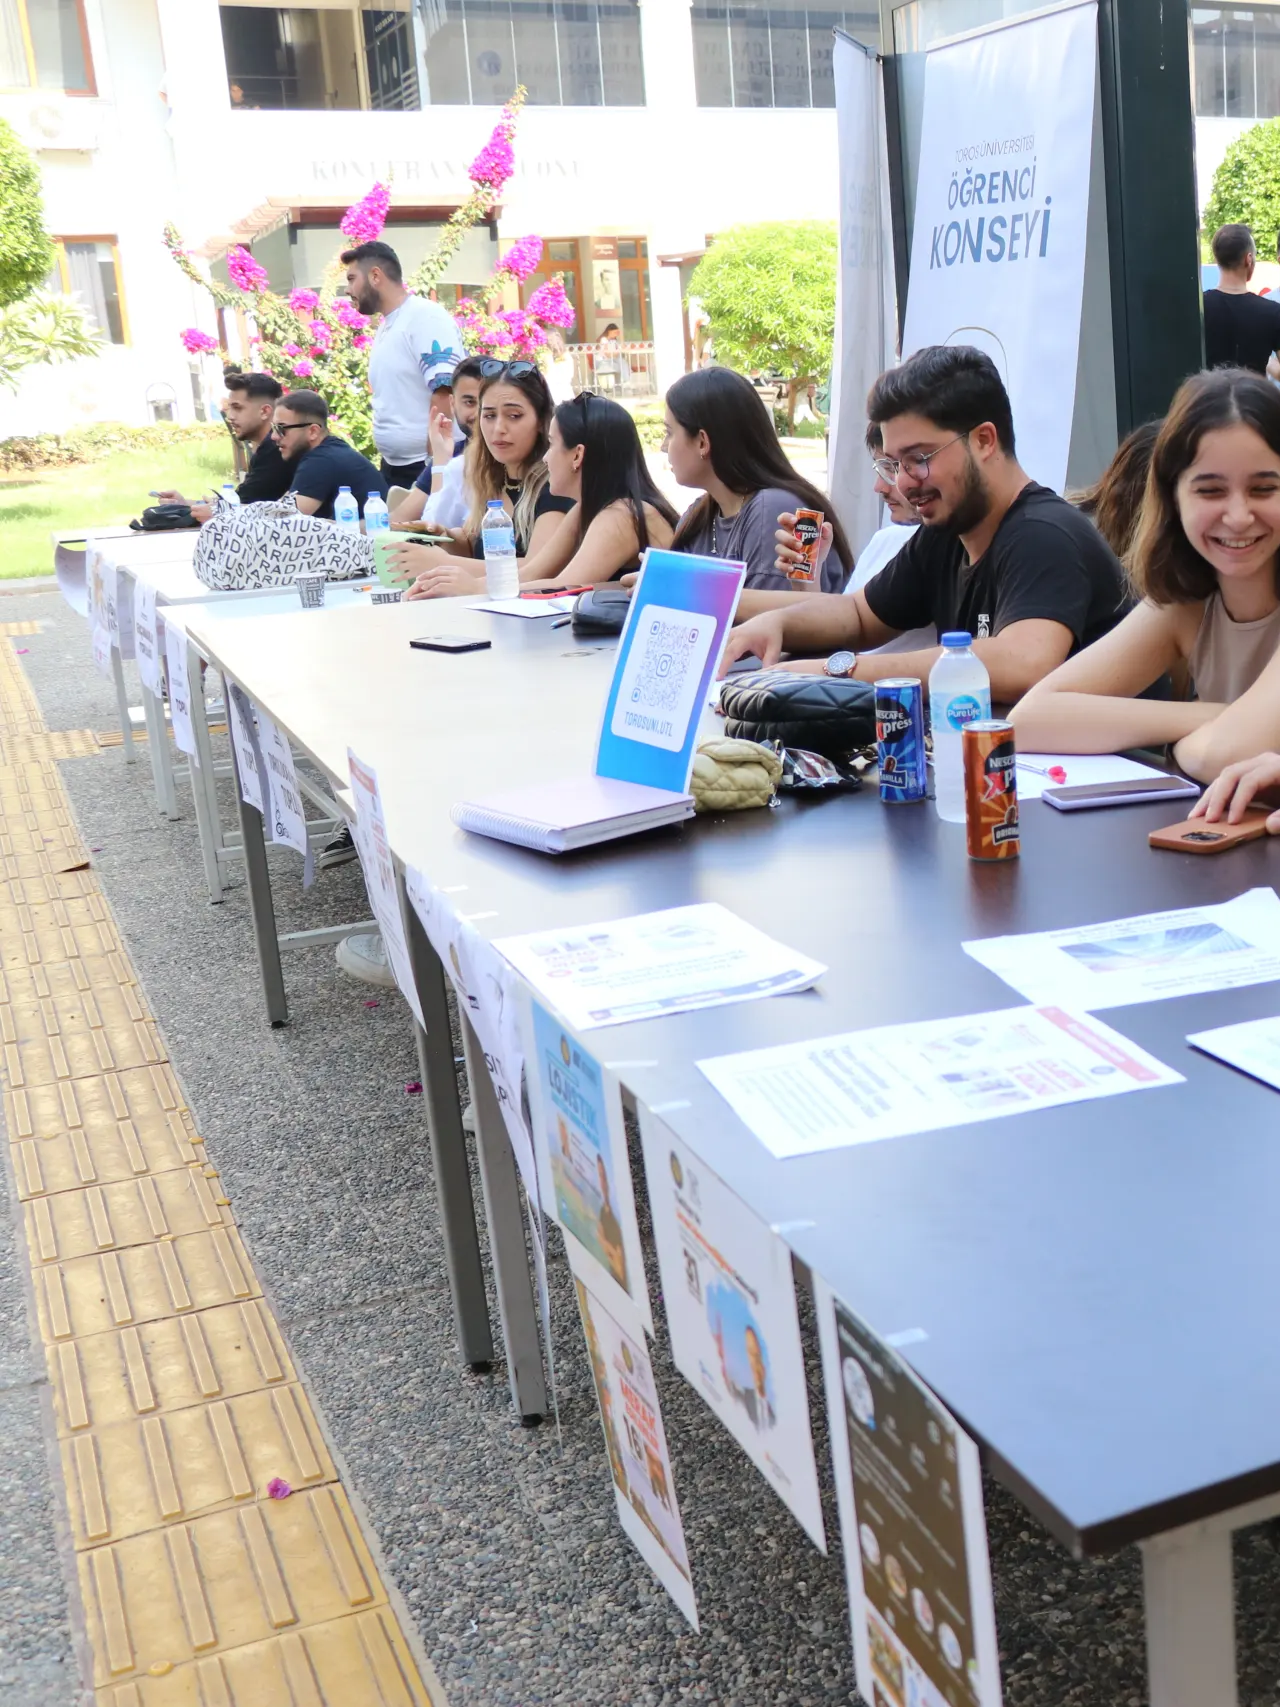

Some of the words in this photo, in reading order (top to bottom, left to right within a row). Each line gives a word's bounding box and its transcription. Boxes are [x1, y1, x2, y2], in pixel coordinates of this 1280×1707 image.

[311, 159, 468, 181] KONFERAN
[947, 155, 1037, 211] ÖĞRENCİ
[929, 195, 1053, 270] KONSEYİ
[948, 709, 967, 717] Pure
[968, 707, 980, 720] Life
